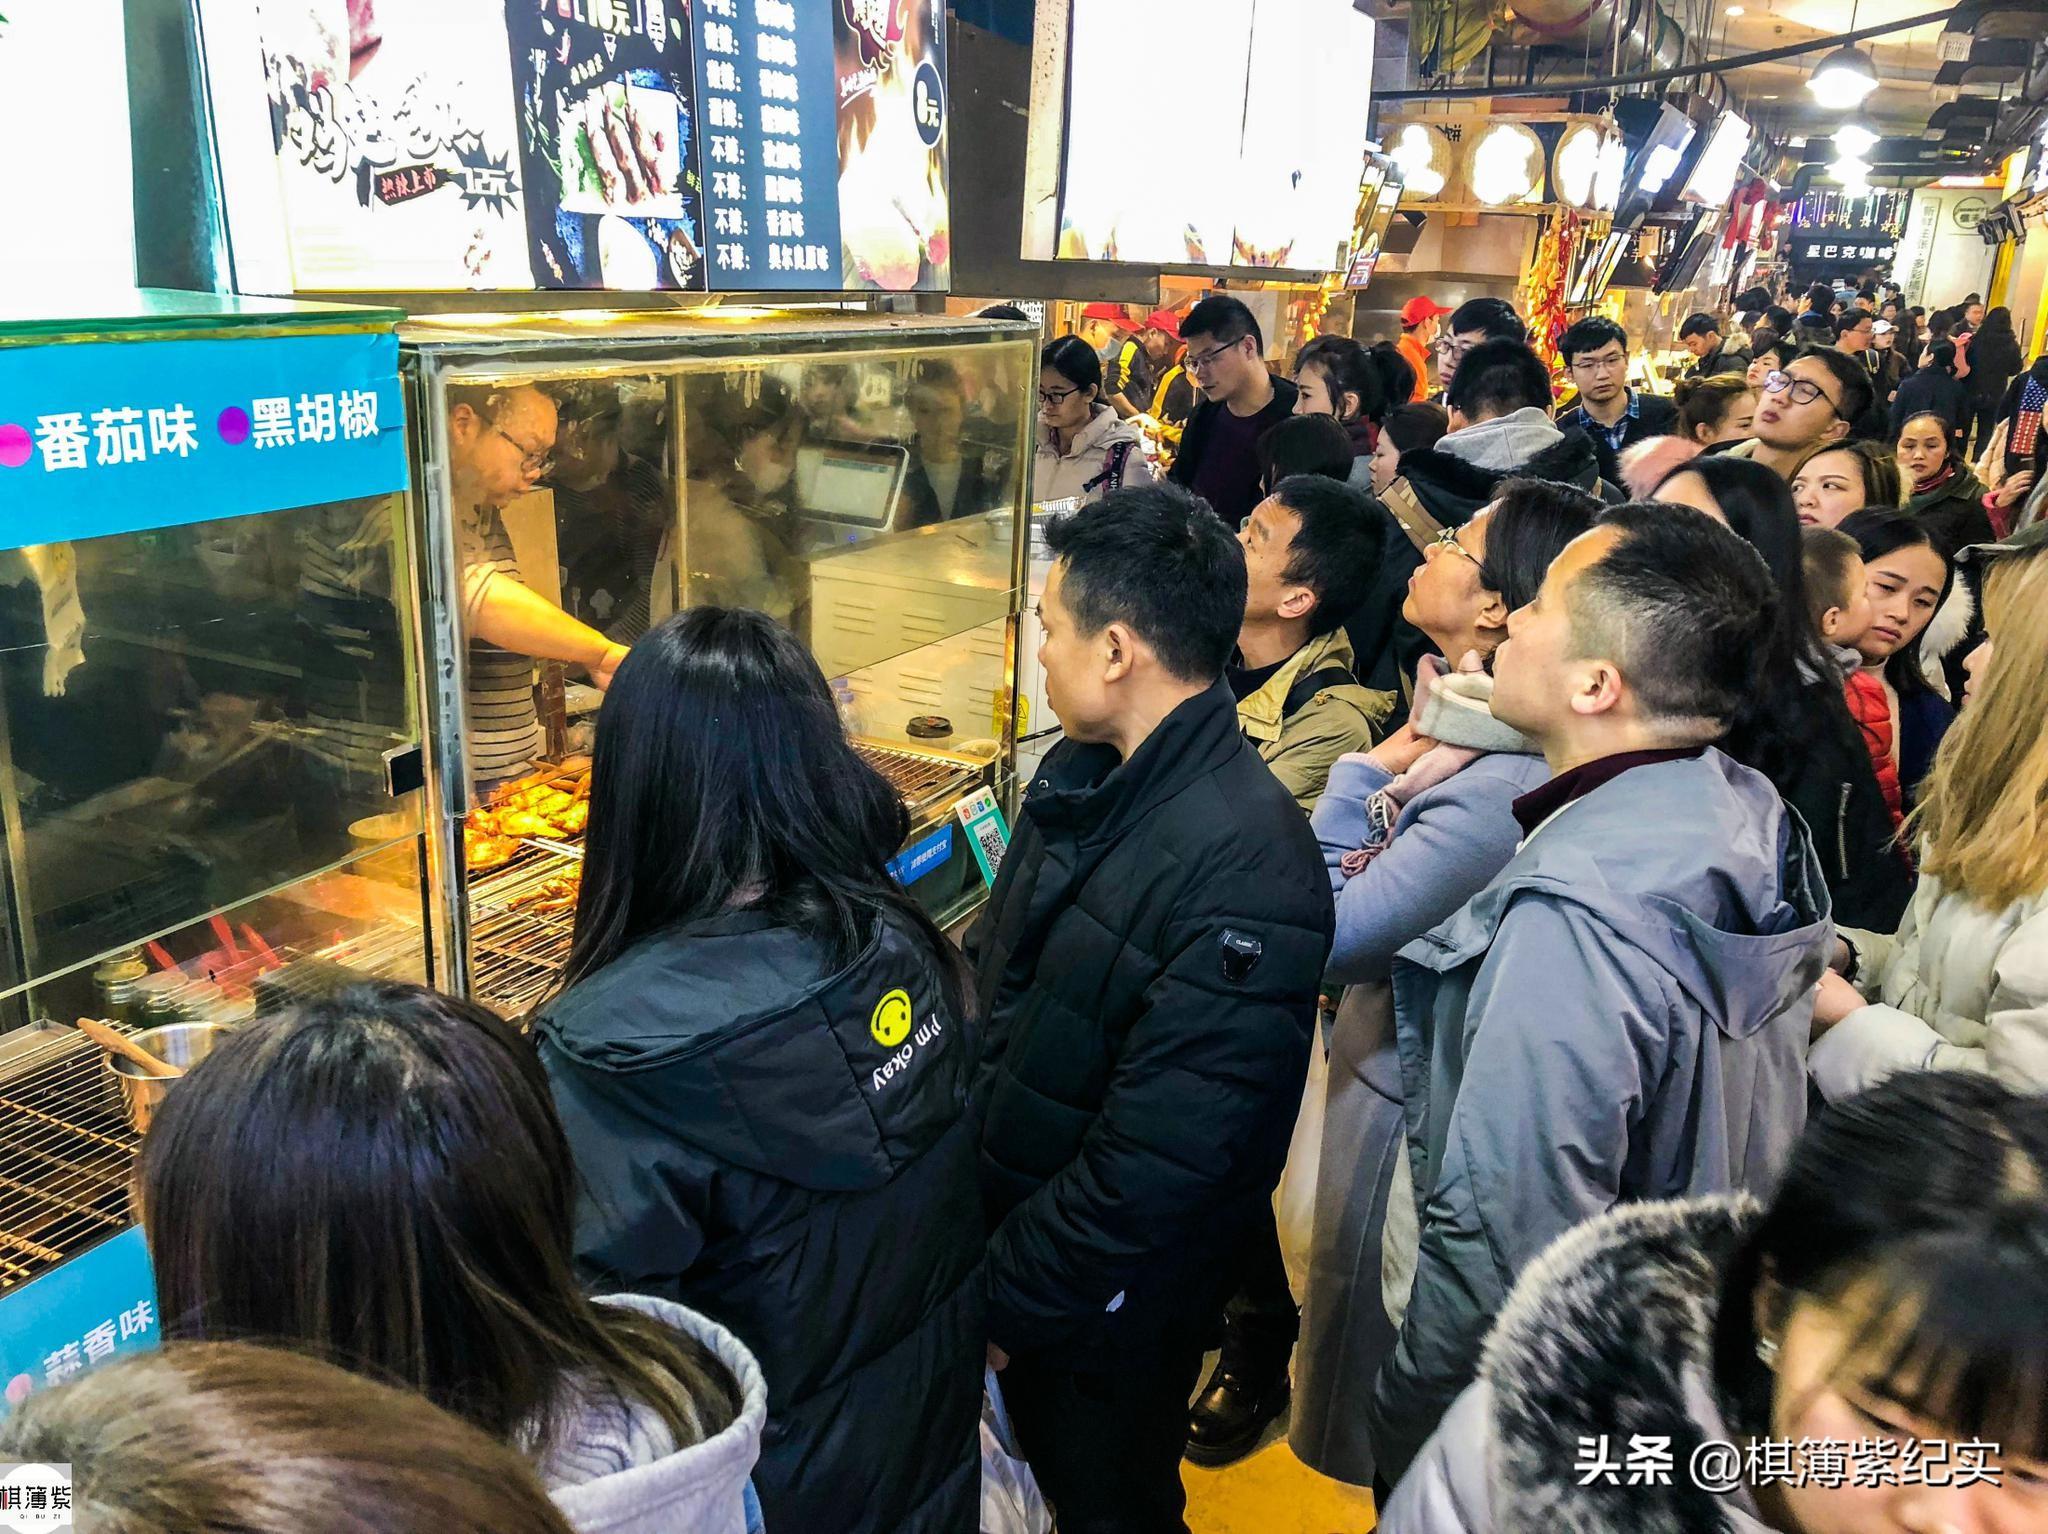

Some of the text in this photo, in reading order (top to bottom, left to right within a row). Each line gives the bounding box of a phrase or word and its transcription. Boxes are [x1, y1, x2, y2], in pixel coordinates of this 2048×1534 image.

[1806, 244, 1896, 261] 星巴克咖啡
[35, 389, 380, 472] 番茄味 黑胡椒
[872, 1012, 942, 1092] I'm okay
[43, 1300, 155, 1388] 蒜香味
